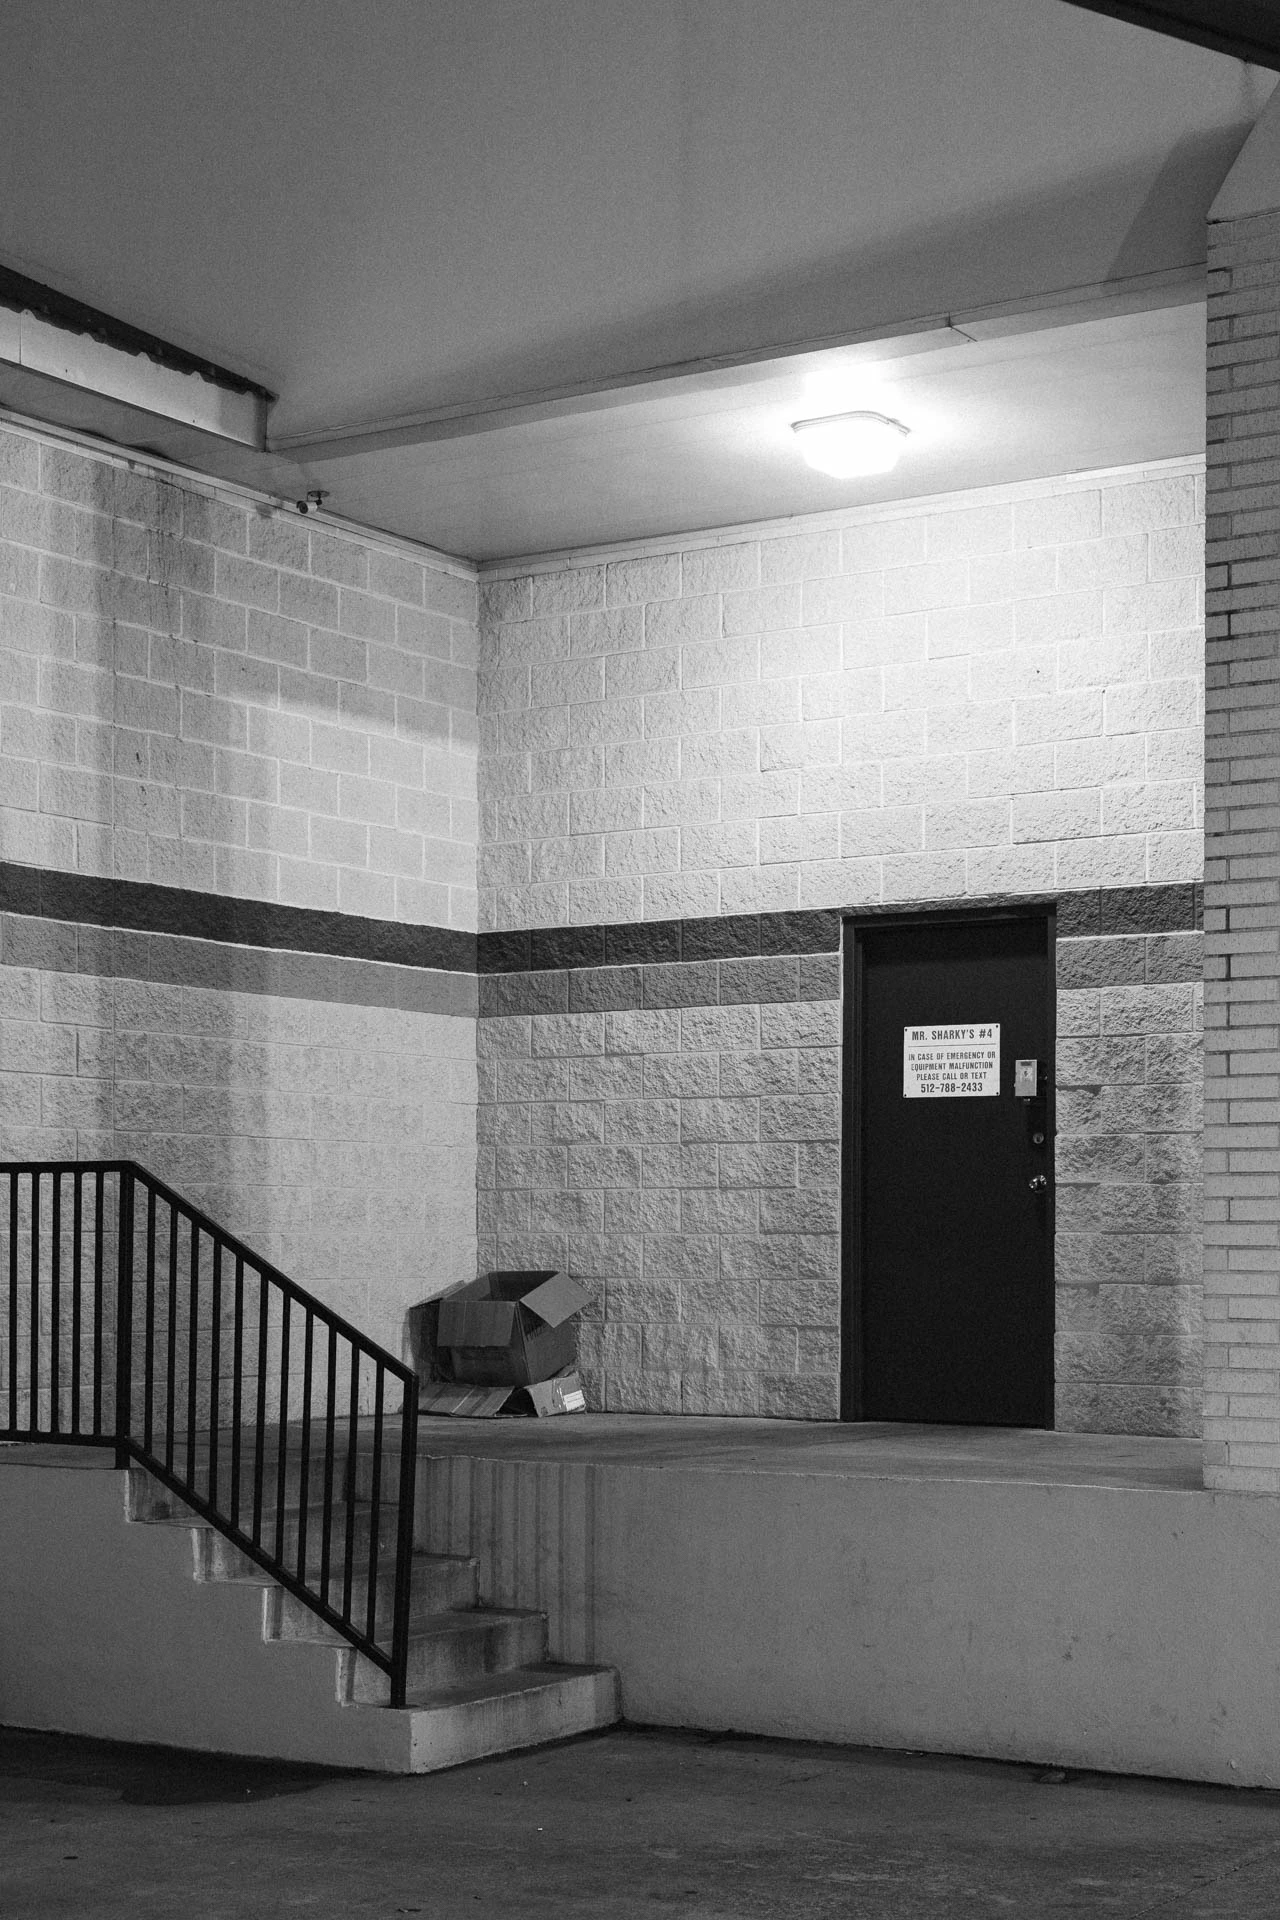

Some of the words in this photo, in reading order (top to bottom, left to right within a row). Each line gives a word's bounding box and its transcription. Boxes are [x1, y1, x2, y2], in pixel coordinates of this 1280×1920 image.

[912, 1031, 928, 1040] MR.
[931, 1028, 974, 1040] SHARKY'S
[979, 1028, 992, 1038] #4
[936, 1052, 944, 1060] OF
[946, 1052, 984, 1060] EMERGENCY
[987, 1051, 996, 1059] OR
[911, 1063, 946, 1072] EQUIPMENT
[949, 1062, 993, 1070] MALFUNCTION
[971, 1072, 987, 1080] TEXT
[920, 1082, 983, 1093] 512-788-2433
